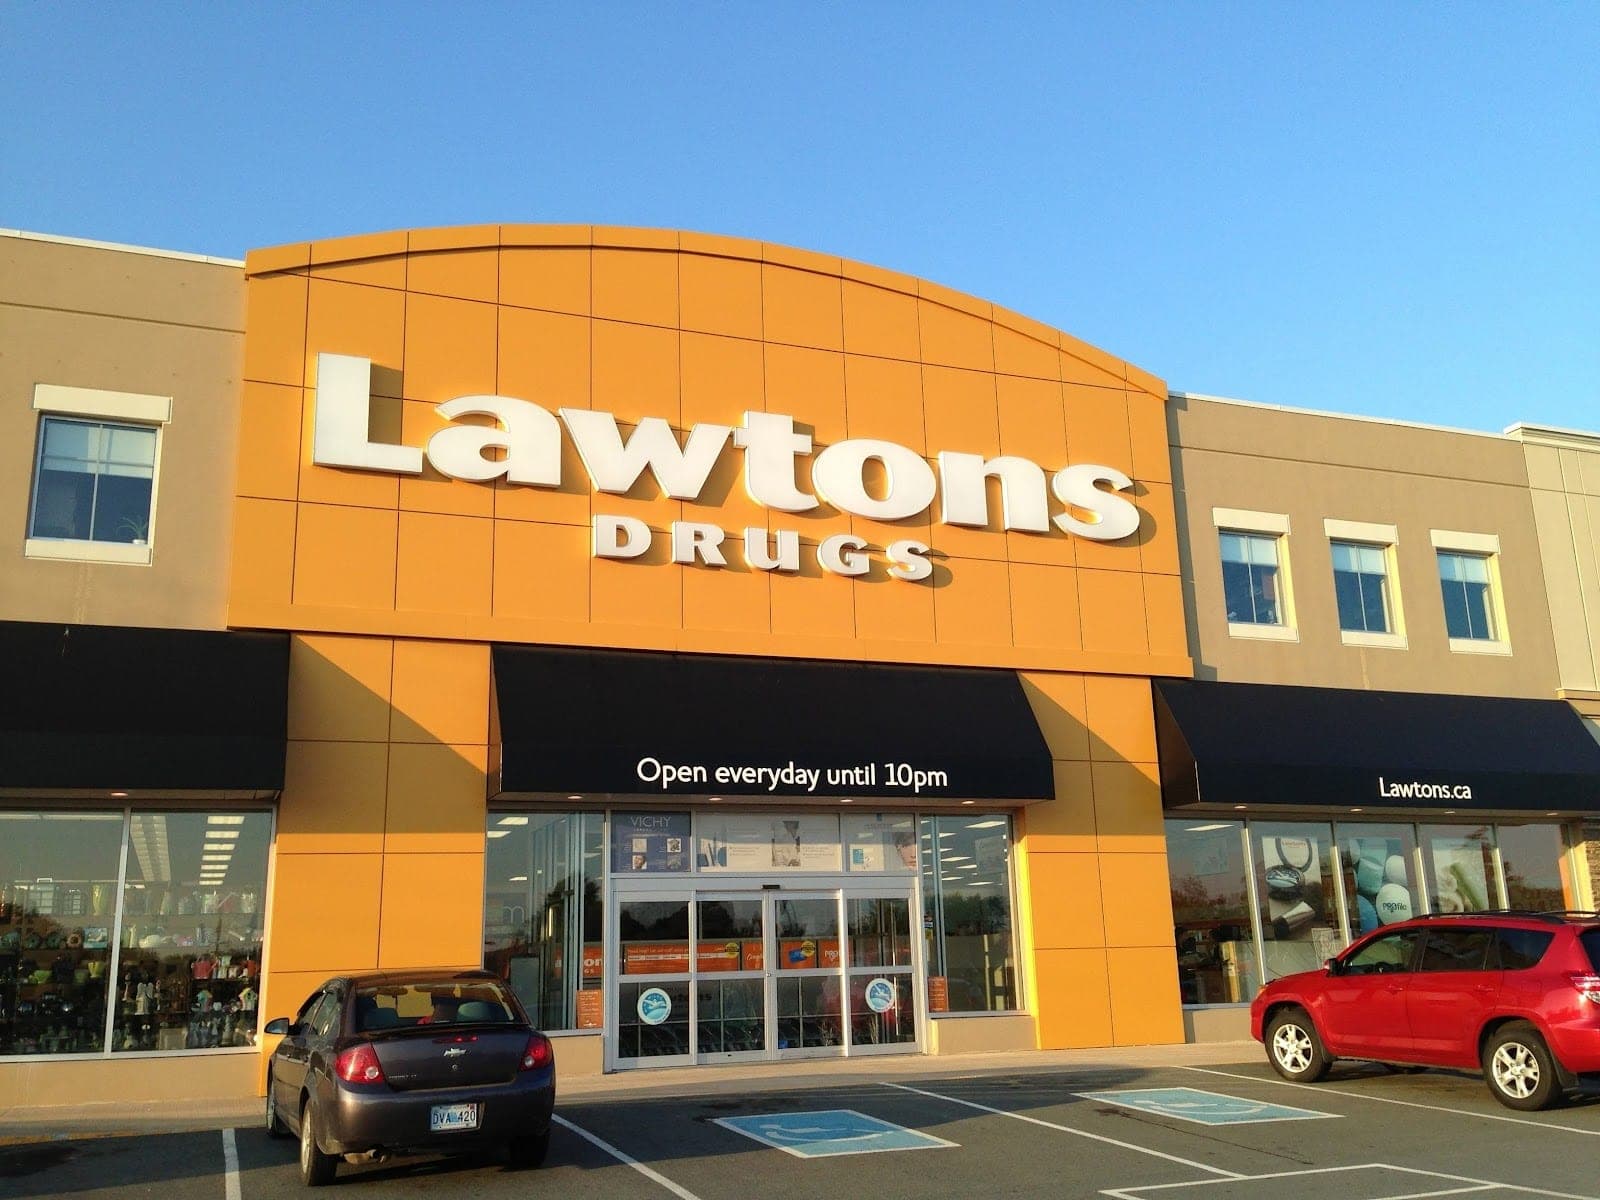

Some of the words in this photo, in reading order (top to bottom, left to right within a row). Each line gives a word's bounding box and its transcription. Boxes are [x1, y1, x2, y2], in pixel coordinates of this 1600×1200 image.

[314, 353, 1141, 541] Lawtons
[592, 514, 934, 582] DRUGS
[637, 757, 707, 789] Open
[715, 761, 820, 791] everyday
[827, 763, 876, 786] until
[884, 763, 948, 792] 10pm
[1379, 776, 1472, 799] Lawtons.ca
[630, 816, 672, 827] VICHY
[433, 1112, 451, 1125] DVA
[458, 1110, 476, 1122] 420
